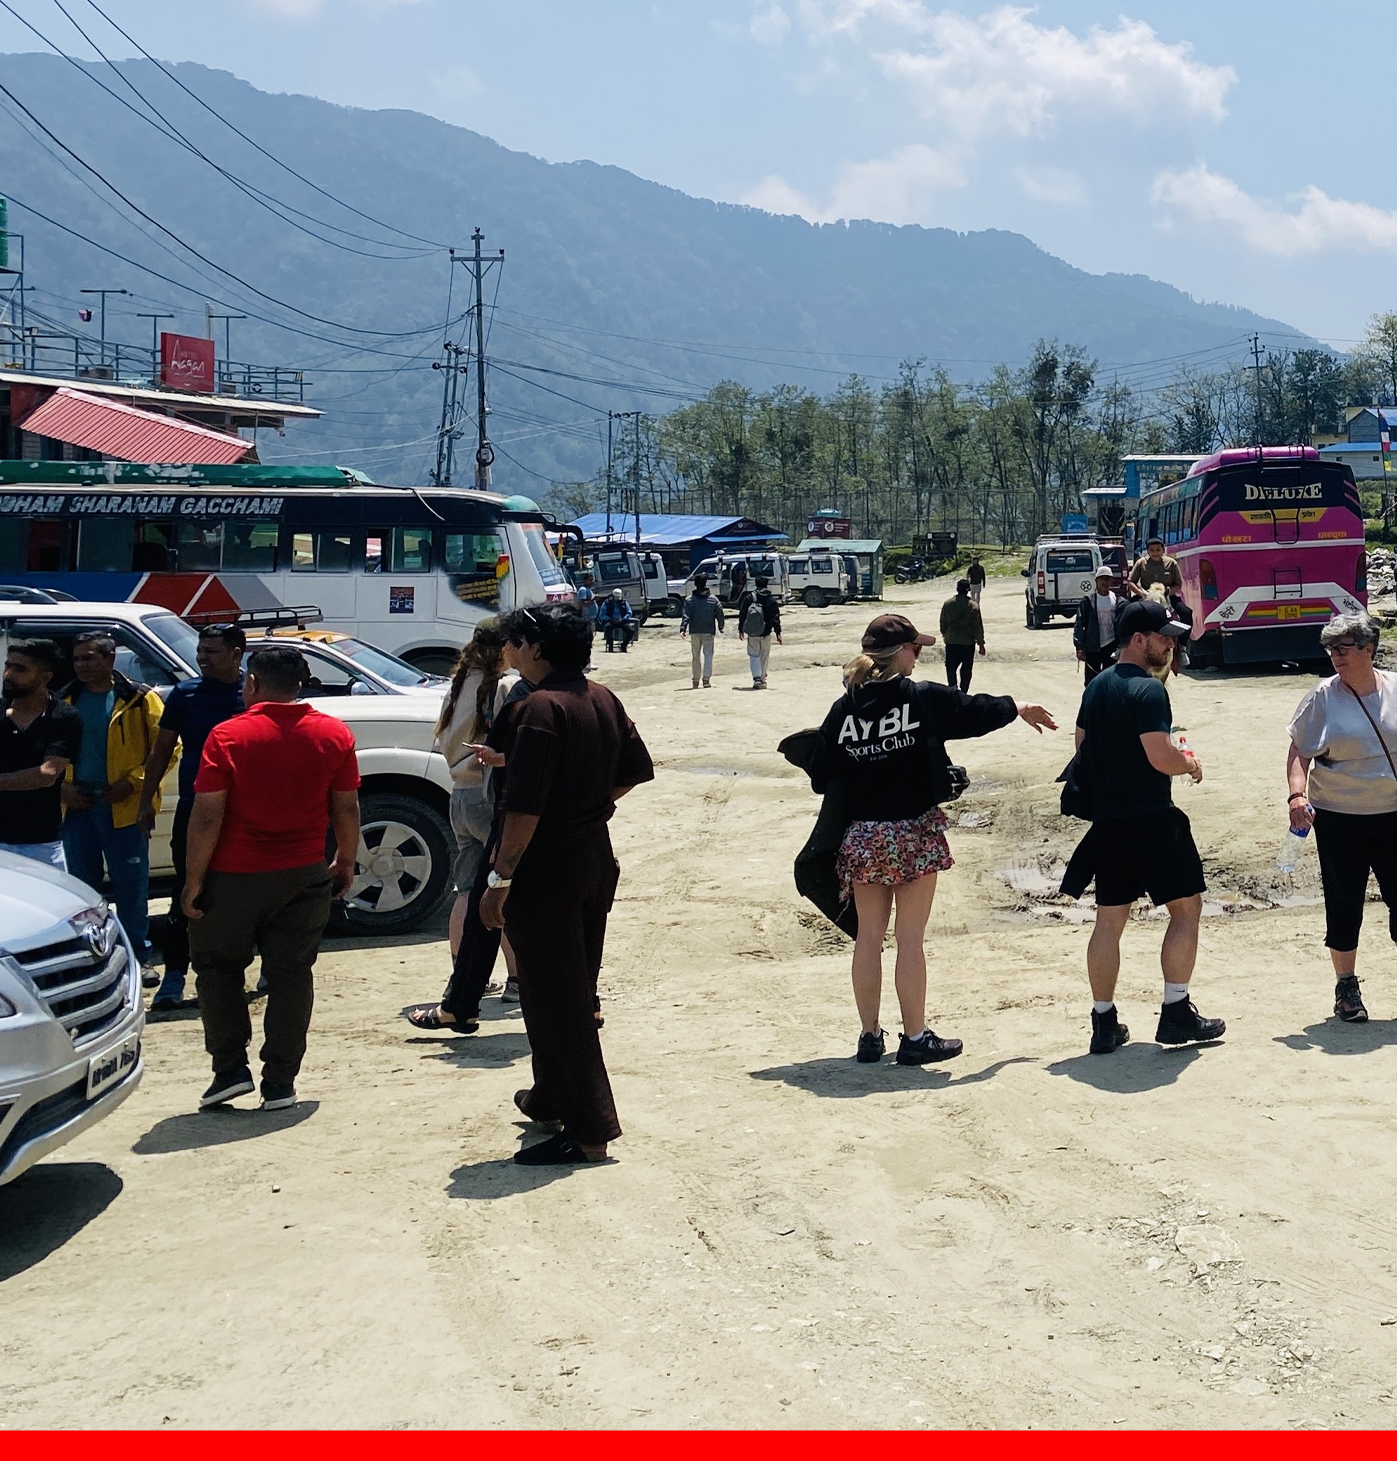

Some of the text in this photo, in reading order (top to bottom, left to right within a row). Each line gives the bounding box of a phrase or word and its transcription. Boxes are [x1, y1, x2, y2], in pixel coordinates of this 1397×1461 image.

[1244, 482, 1322, 500] DELUXE
[69, 496, 176, 513] SHARANAM
[180, 497, 283, 514] GACCHAMI
[838, 703, 920, 745] AYBL
[845, 733, 915, 762] Sports Club
